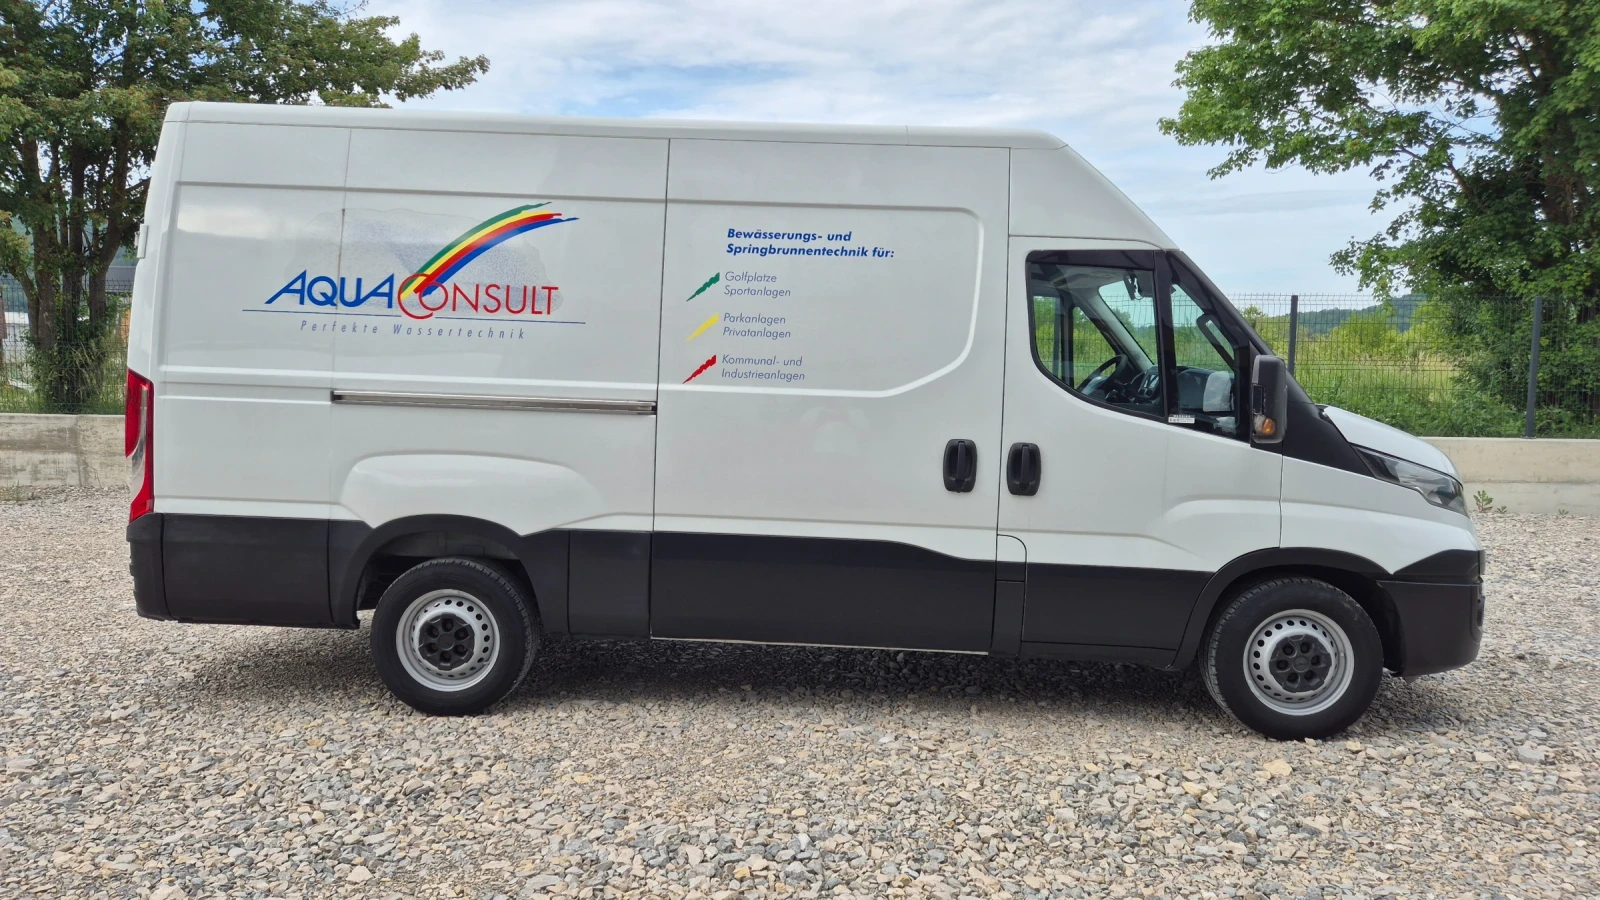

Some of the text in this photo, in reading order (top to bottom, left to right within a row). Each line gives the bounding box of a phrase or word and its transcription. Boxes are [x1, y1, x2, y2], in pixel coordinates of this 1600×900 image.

[727, 228, 852, 243] Bewässerungs- und
[726, 243, 895, 258] Springbrunnentechnik für:
[264, 269, 395, 310] AQUA
[723, 285, 791, 299] Sportanlagen
[723, 313, 786, 327] Parkanlagen
[300, 320, 525, 340] Perfekte Wassertechnik
[722, 327, 791, 341] Privatanlagen
[721, 354, 803, 367] Kommunal- und
[721, 368, 806, 383] Industrieanlagen
